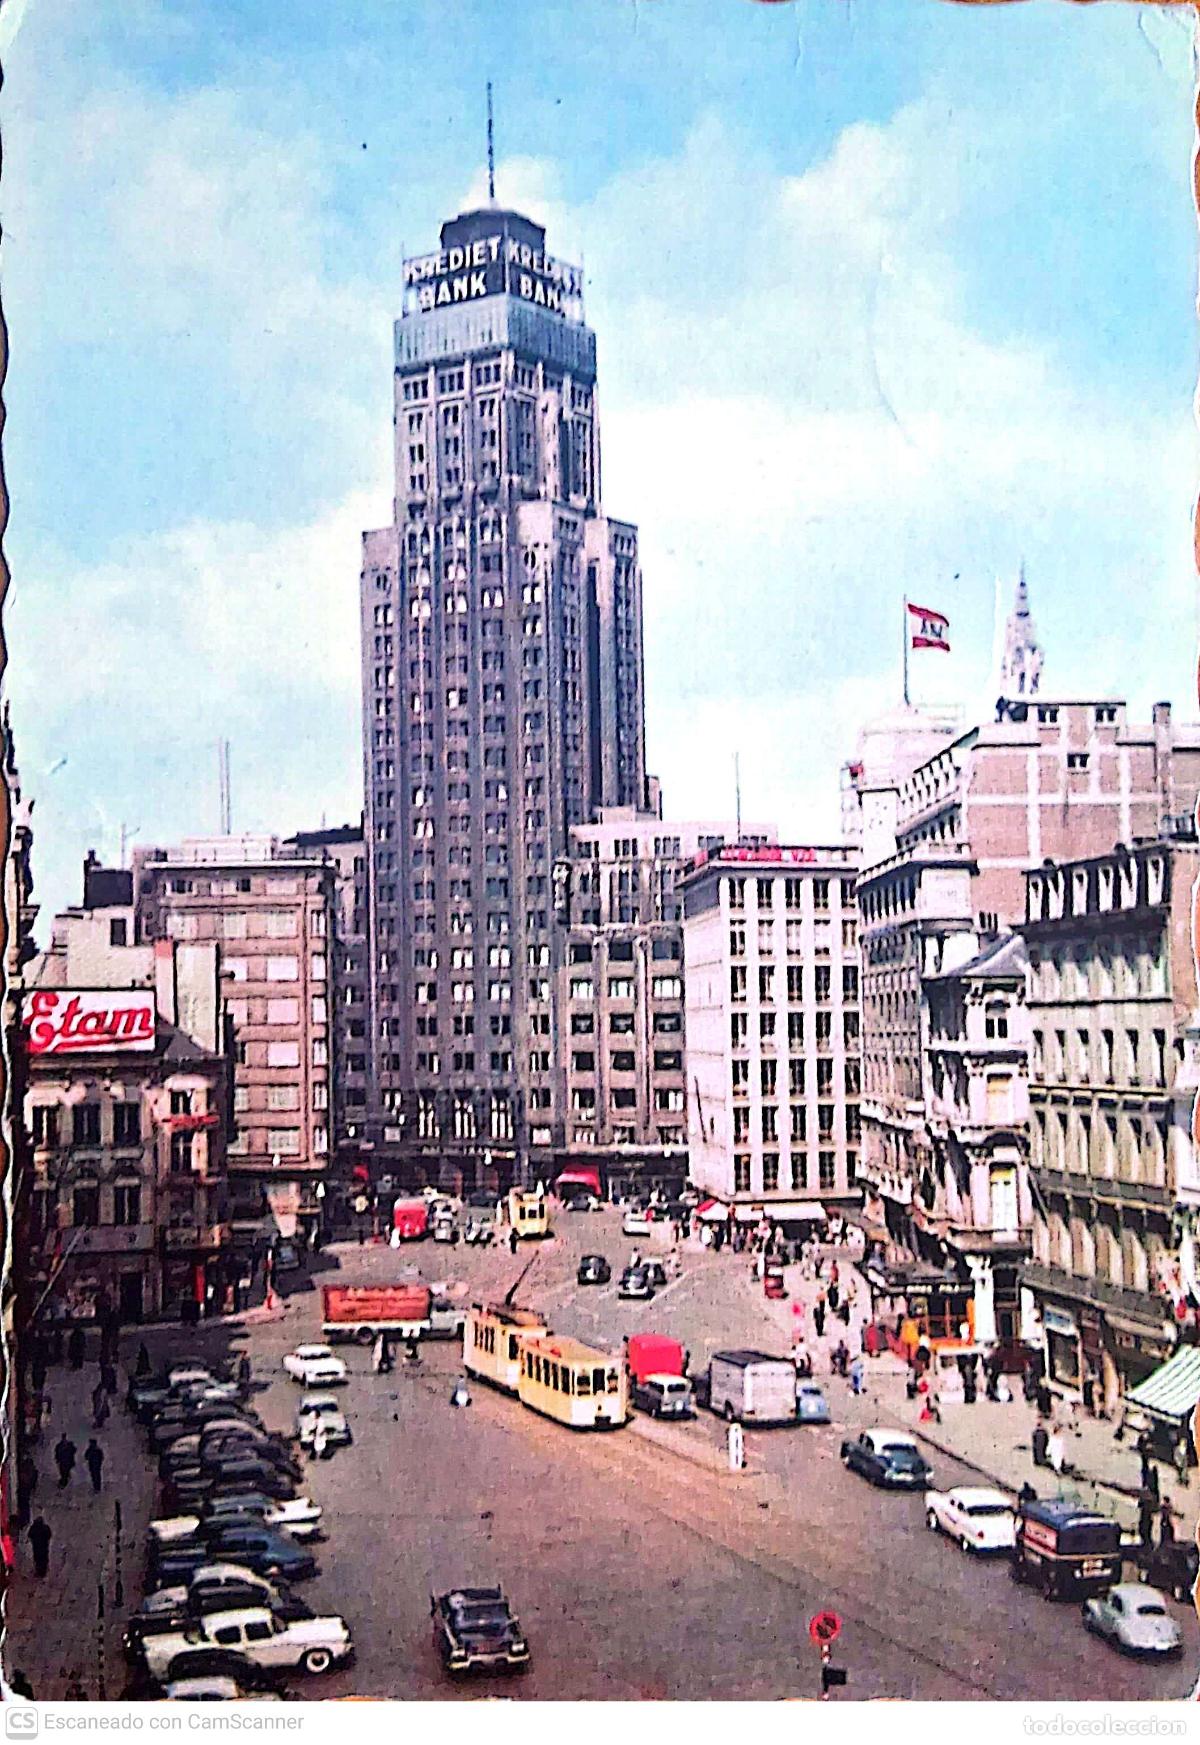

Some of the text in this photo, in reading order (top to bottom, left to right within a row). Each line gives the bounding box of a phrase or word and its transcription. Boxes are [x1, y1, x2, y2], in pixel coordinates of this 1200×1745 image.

[403, 235, 502, 283] KREDIET
[419, 271, 487, 308] BANK
[24, 991, 154, 1052] Etam
